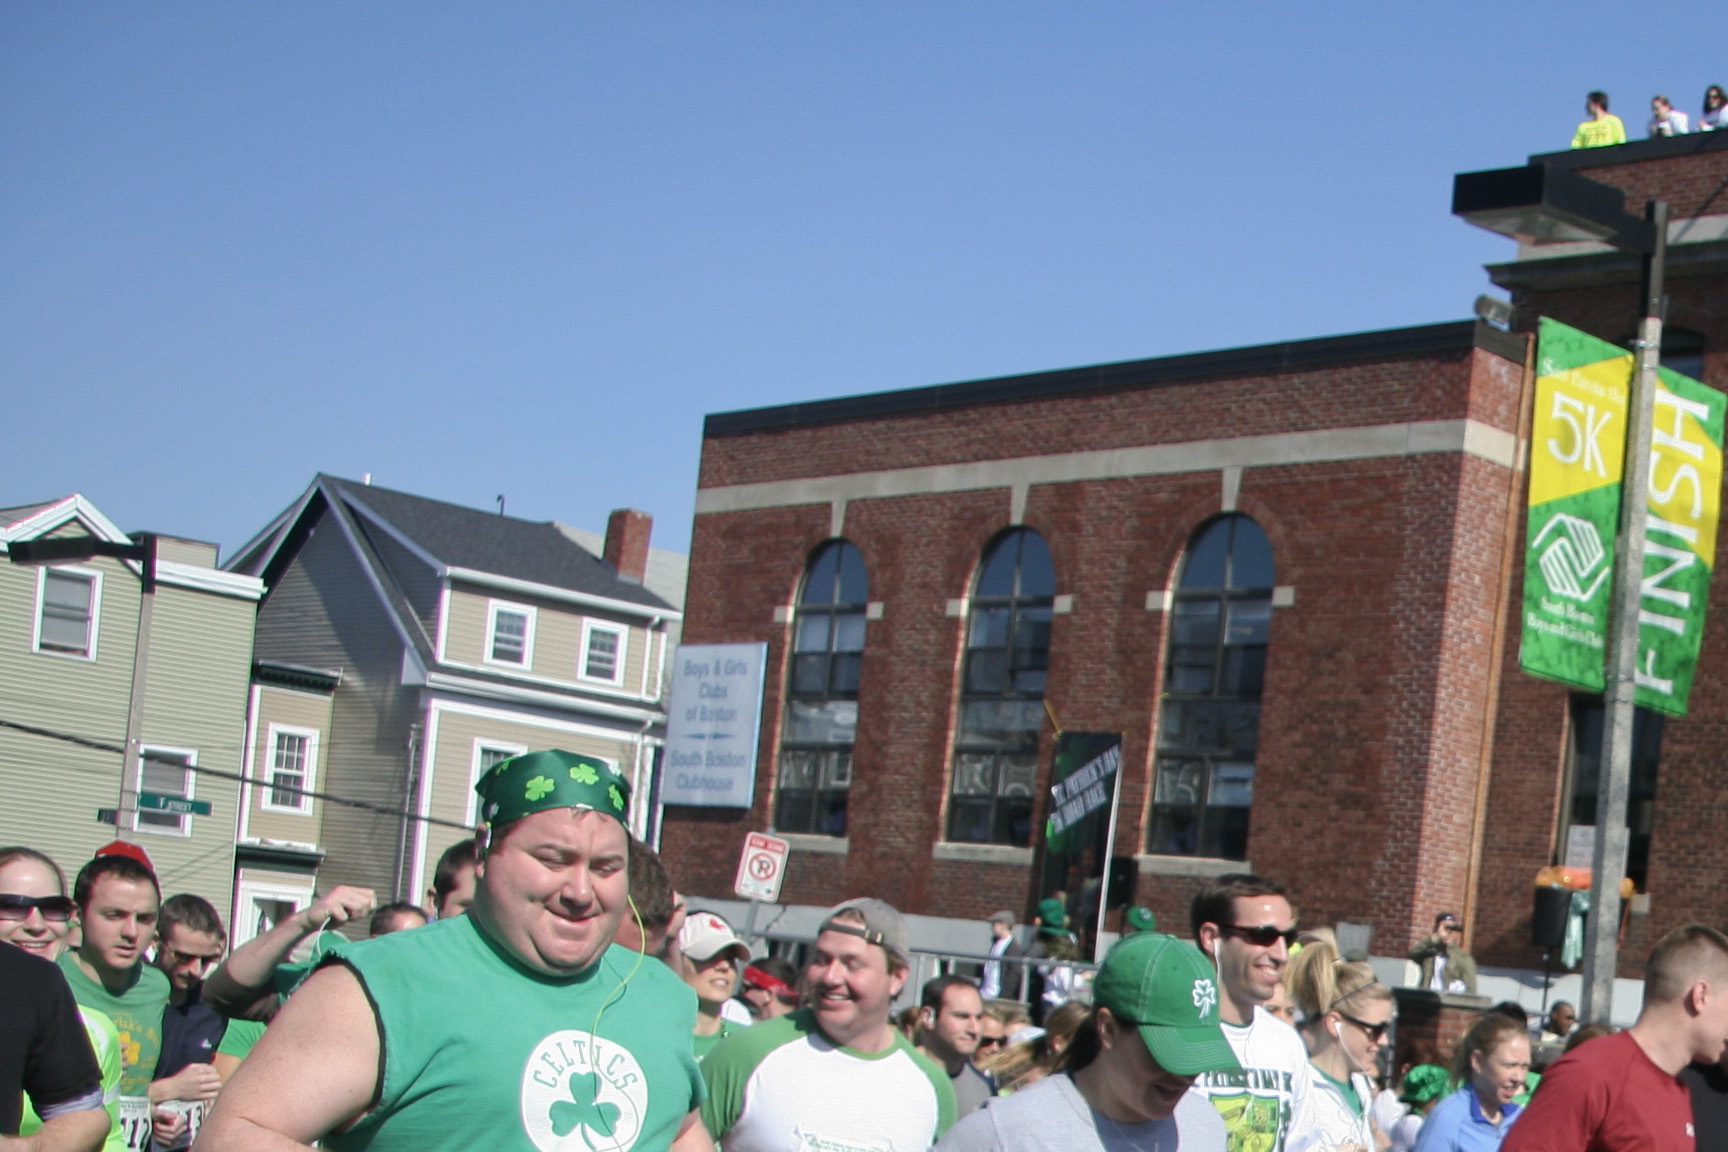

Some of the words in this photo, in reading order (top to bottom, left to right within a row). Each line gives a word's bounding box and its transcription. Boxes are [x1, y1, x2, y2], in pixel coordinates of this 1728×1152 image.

[1547, 390, 1614, 479] 5K
[1635, 387, 1710, 696] FINISH
[684, 659, 709, 679] Boys
[724, 658, 747, 675] Girls
[699, 682, 729, 698] Clubs
[685, 705, 698, 721] of
[699, 704, 737, 721] Boston
[670, 749, 703, 767] South
[705, 749, 746, 768] Boston
[676, 773, 733, 790] Clubhouse
[533, 1039, 638, 1090] CELTICS
